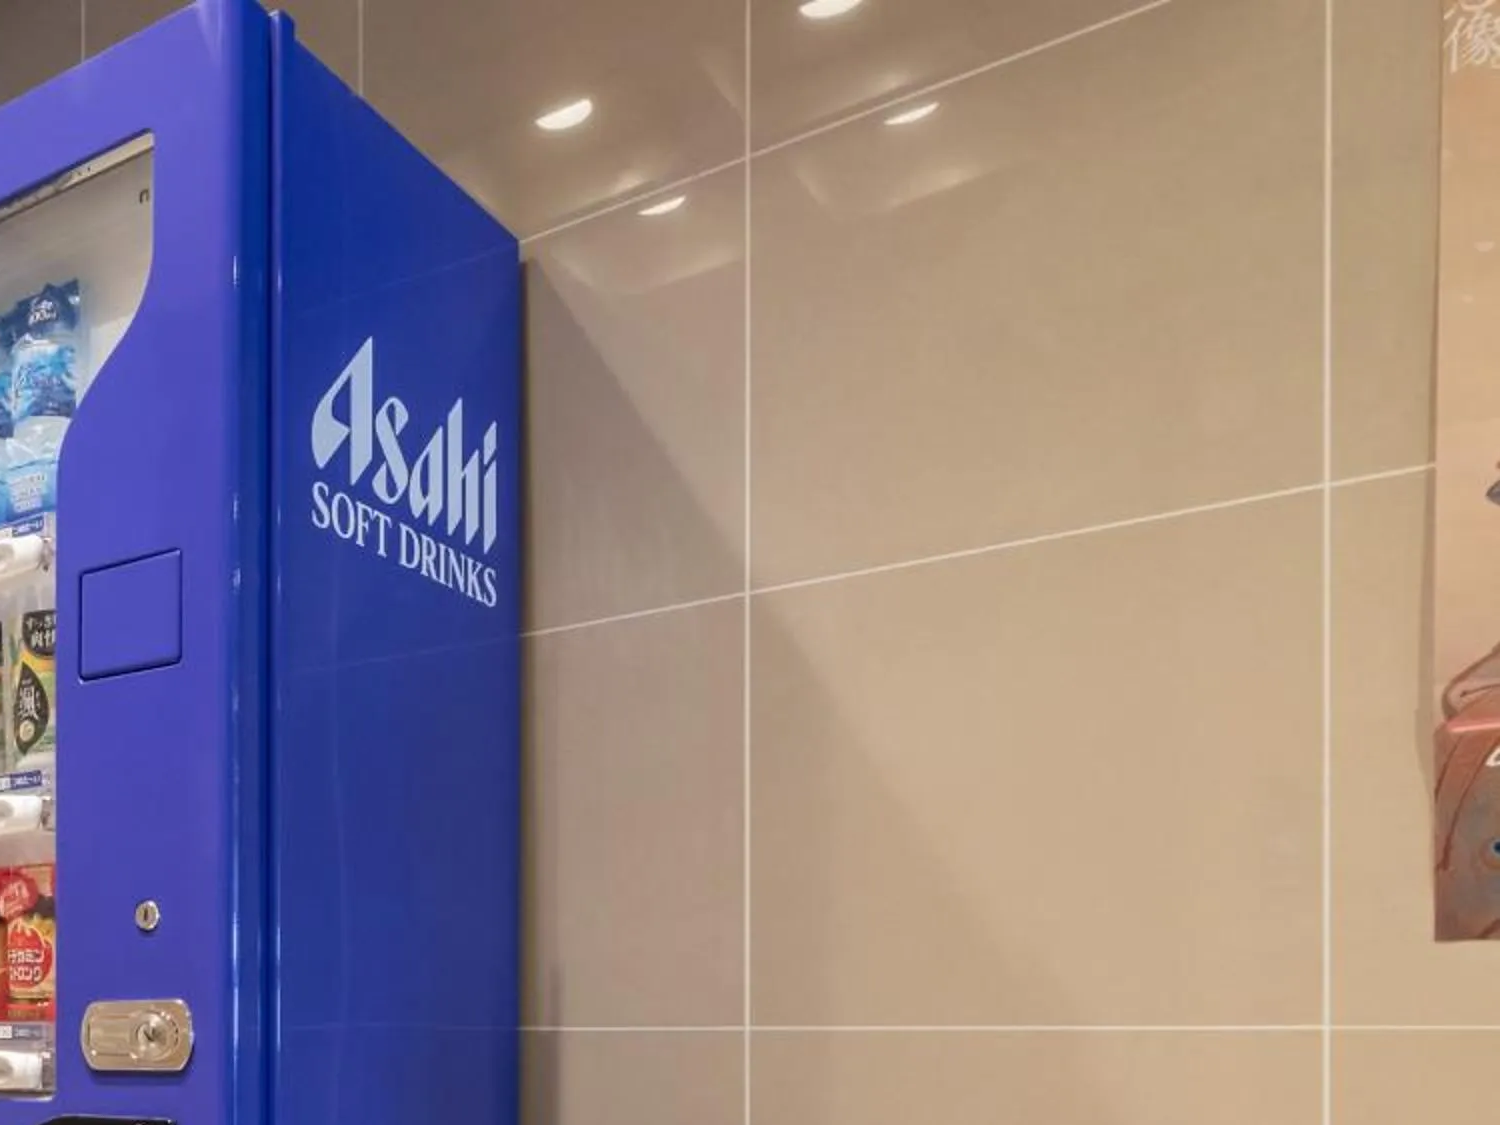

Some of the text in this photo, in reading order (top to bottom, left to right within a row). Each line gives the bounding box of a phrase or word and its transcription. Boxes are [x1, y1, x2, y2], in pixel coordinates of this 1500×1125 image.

[311, 335, 497, 555] Asahi
[311, 481, 497, 608] SOFT DRINKS
